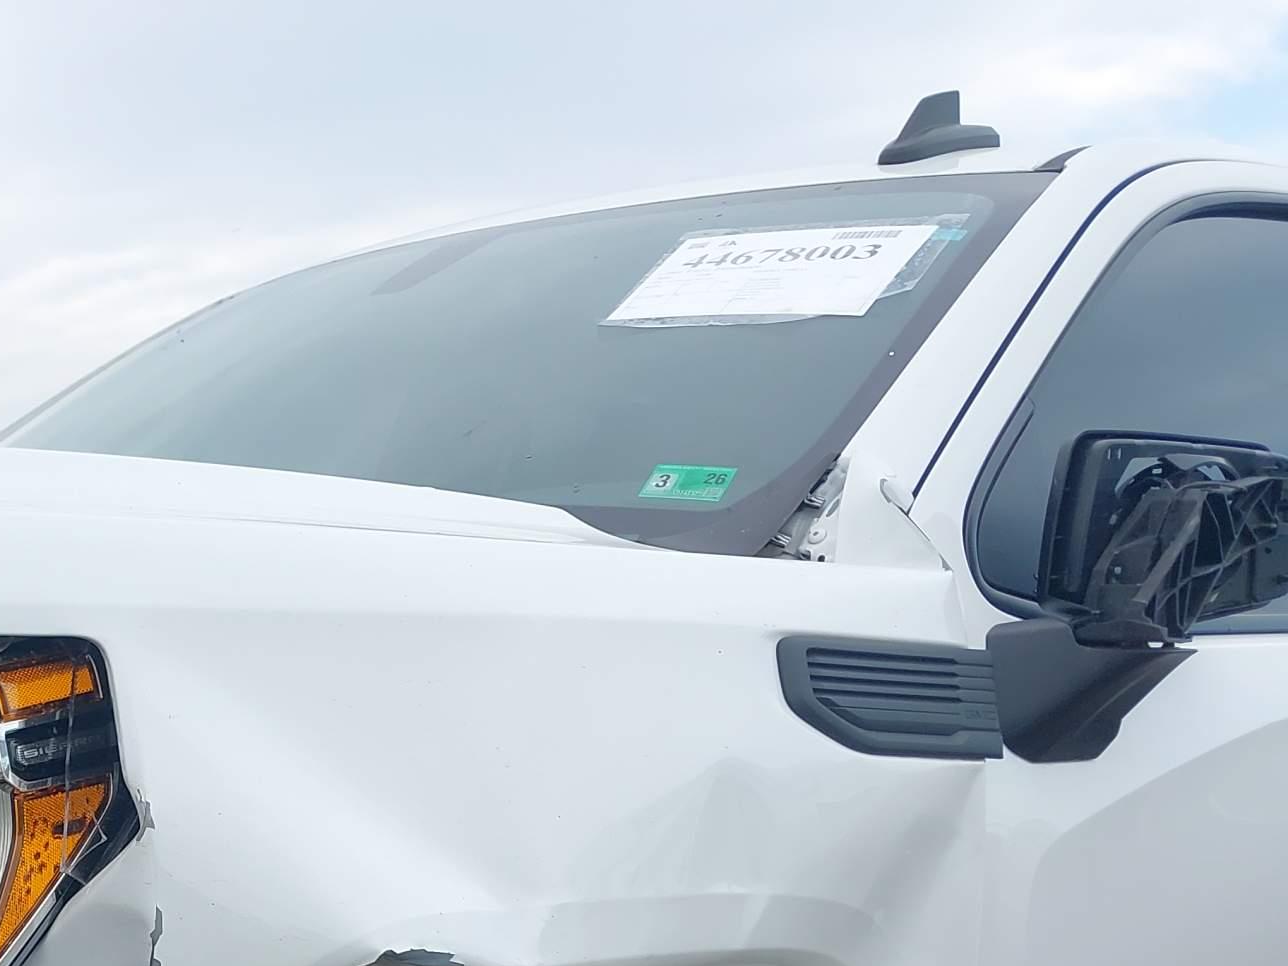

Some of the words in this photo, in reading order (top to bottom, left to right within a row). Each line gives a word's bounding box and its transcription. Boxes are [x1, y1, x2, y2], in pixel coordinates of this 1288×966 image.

[682, 244, 882, 268] 44678003
[655, 474, 672, 488] 3
[703, 472, 728, 486] 26
